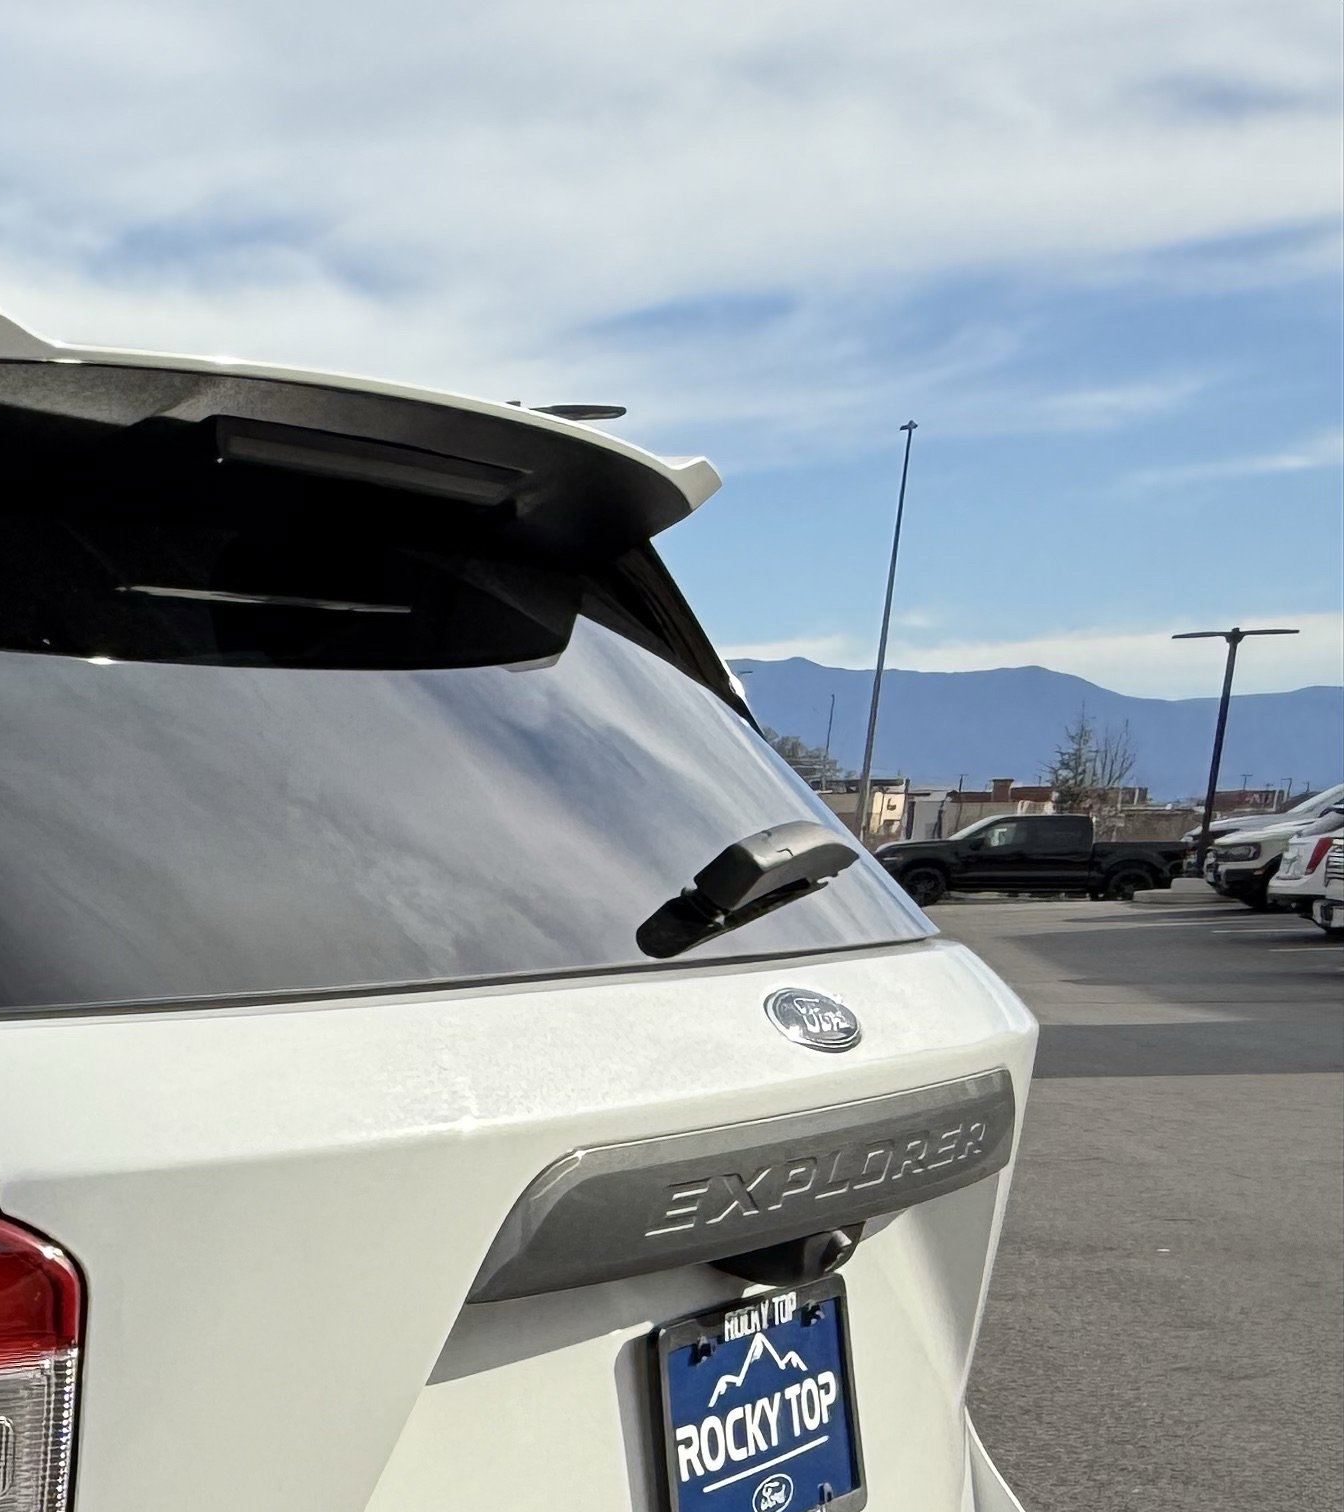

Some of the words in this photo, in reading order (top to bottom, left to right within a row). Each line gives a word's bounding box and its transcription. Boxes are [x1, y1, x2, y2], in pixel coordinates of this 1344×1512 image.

[645, 1121, 987, 1237] EXPLORER
[772, 1291, 797, 1326] TOP
[676, 1391, 782, 1482] ROCKY
[785, 1371, 836, 1437] TOP
